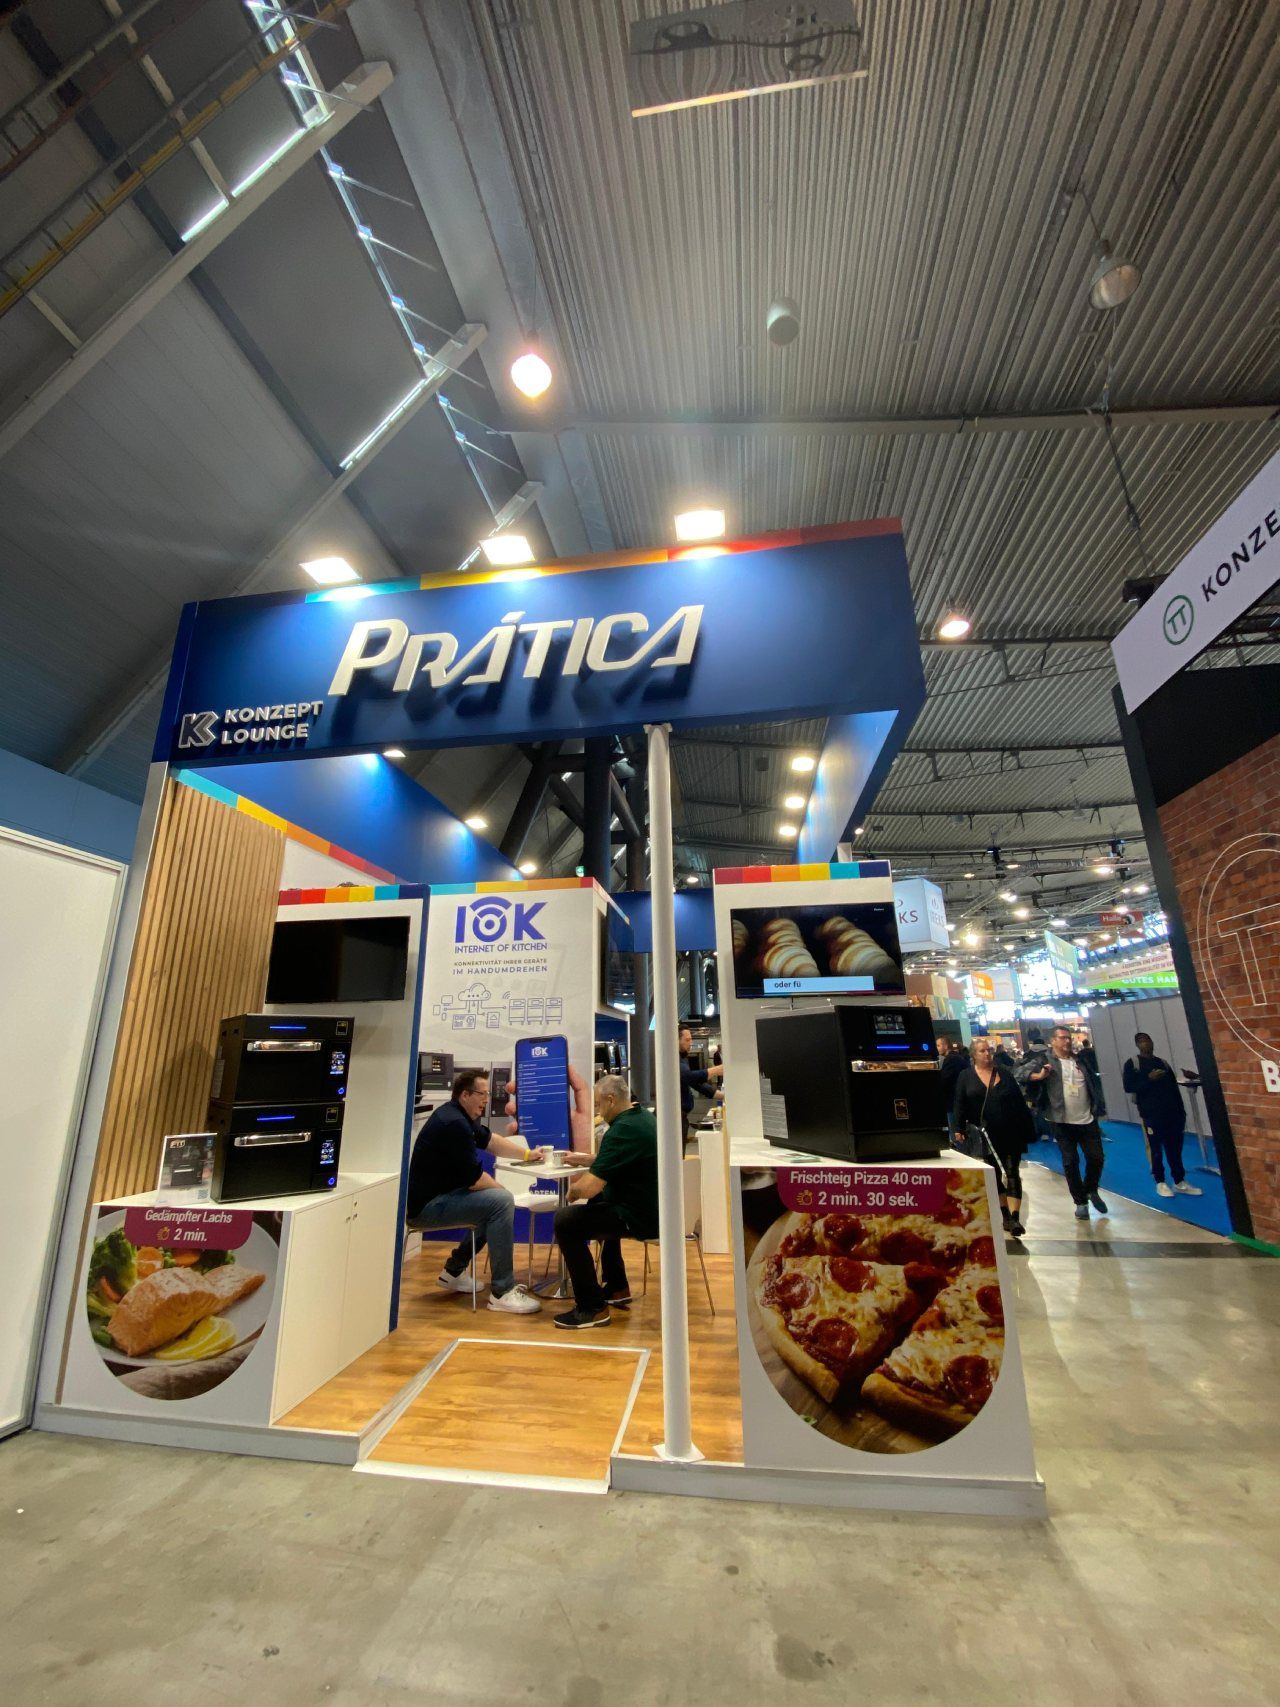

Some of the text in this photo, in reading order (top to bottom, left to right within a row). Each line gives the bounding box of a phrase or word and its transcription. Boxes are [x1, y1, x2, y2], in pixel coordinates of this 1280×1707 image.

[328, 604, 704, 696] PRÁTICA
[224, 700, 323, 723] KONZEPT
[221, 723, 309, 745] LOUNGE
[455, 942, 548, 954] INTERNET OF KITCHEN
[467, 965, 548, 975] HANDUMDREHEN
[790, 1171, 932, 1187] Frischteig Pizza 40 cm
[818, 1191, 919, 1207] 2 min. 30 sek.
[145, 1209, 233, 1224] Gedämpfter Lachs
[173, 1228, 208, 1241] 2 min.
